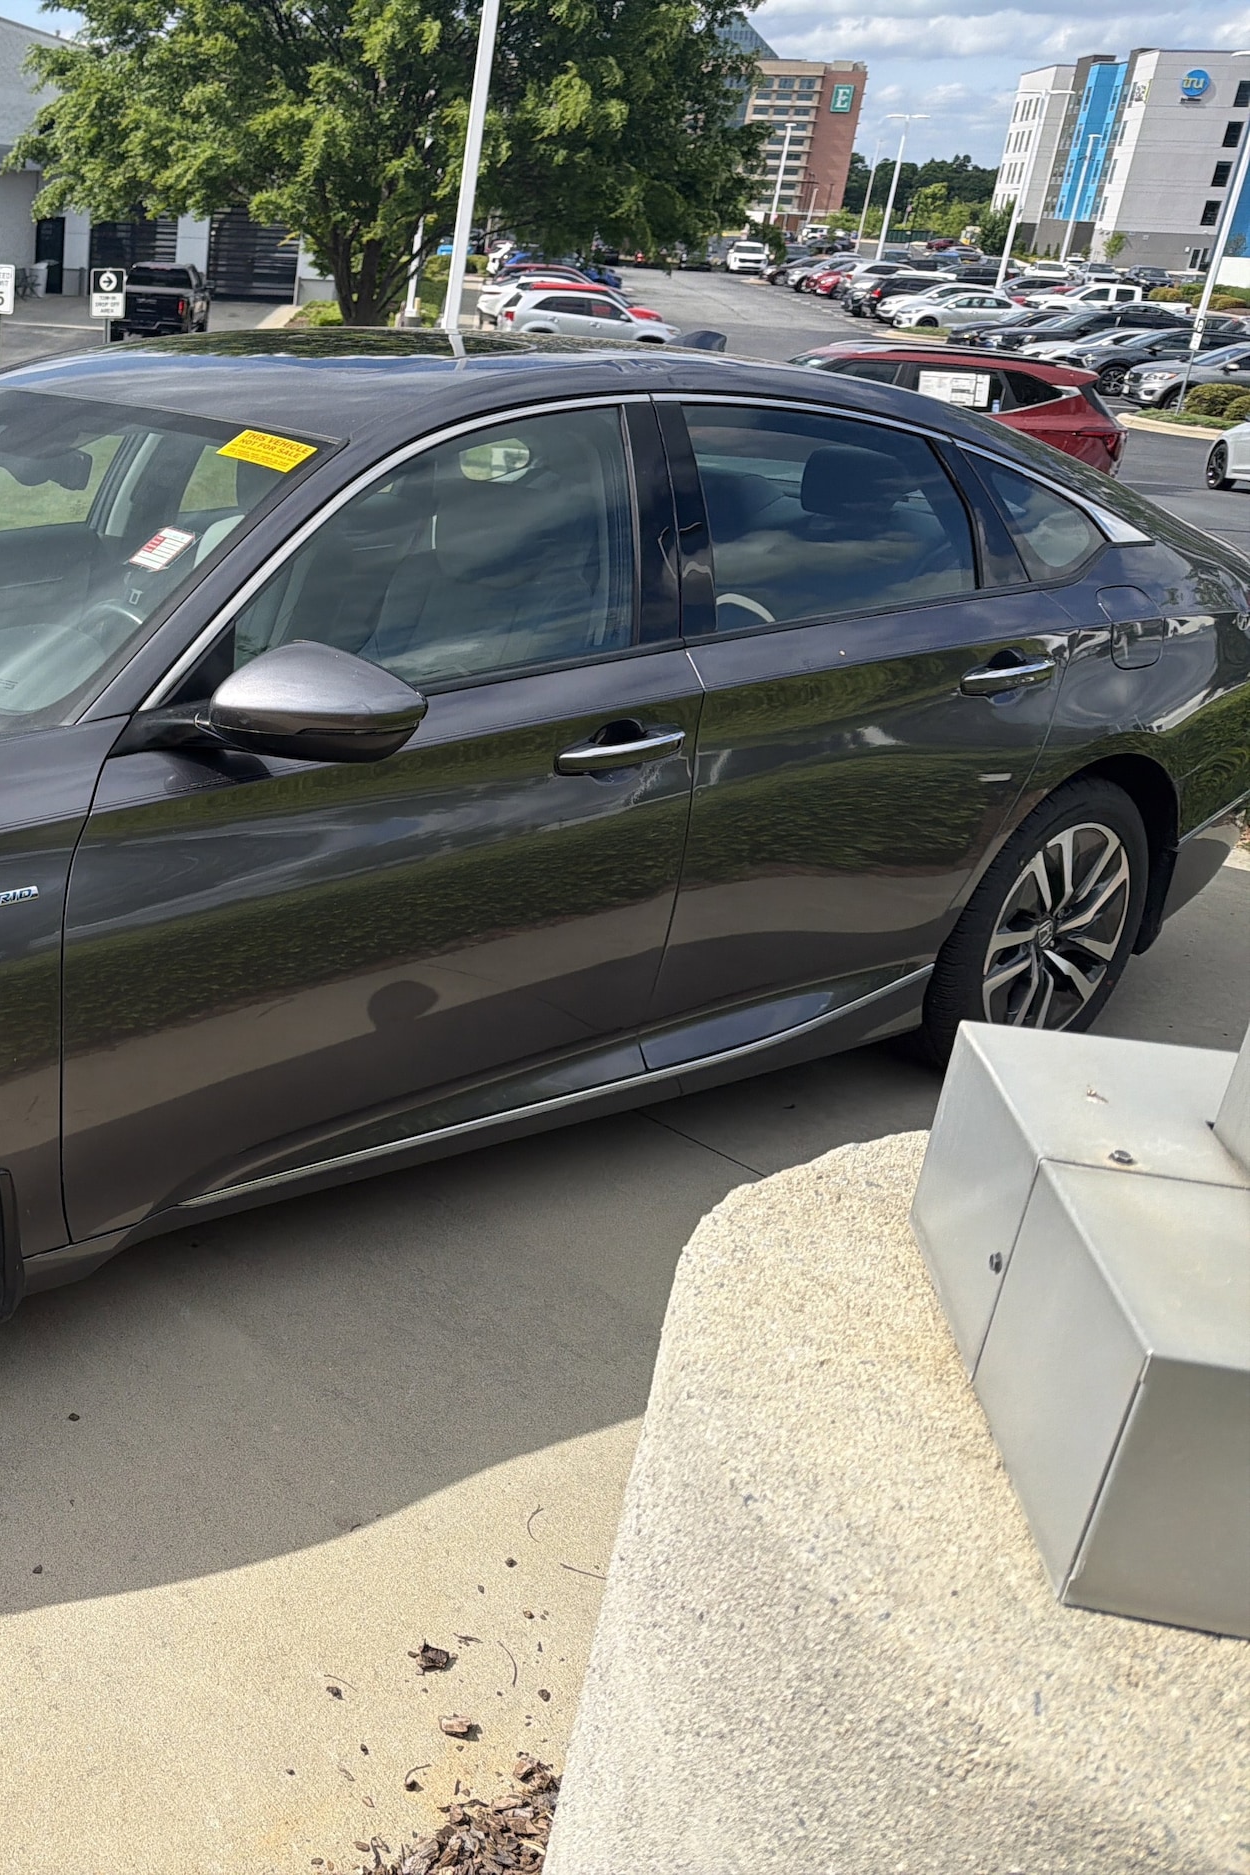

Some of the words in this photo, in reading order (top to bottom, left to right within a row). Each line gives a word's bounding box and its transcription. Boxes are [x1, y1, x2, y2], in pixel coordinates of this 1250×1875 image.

[835, 88, 850, 108] E
[239, 438, 257, 446] NOT
[257, 442, 276, 451] FOR
[277, 448, 302, 459] SALE
[244, 432, 267, 441] THIS
[268, 436, 310, 454] VEHICLE
